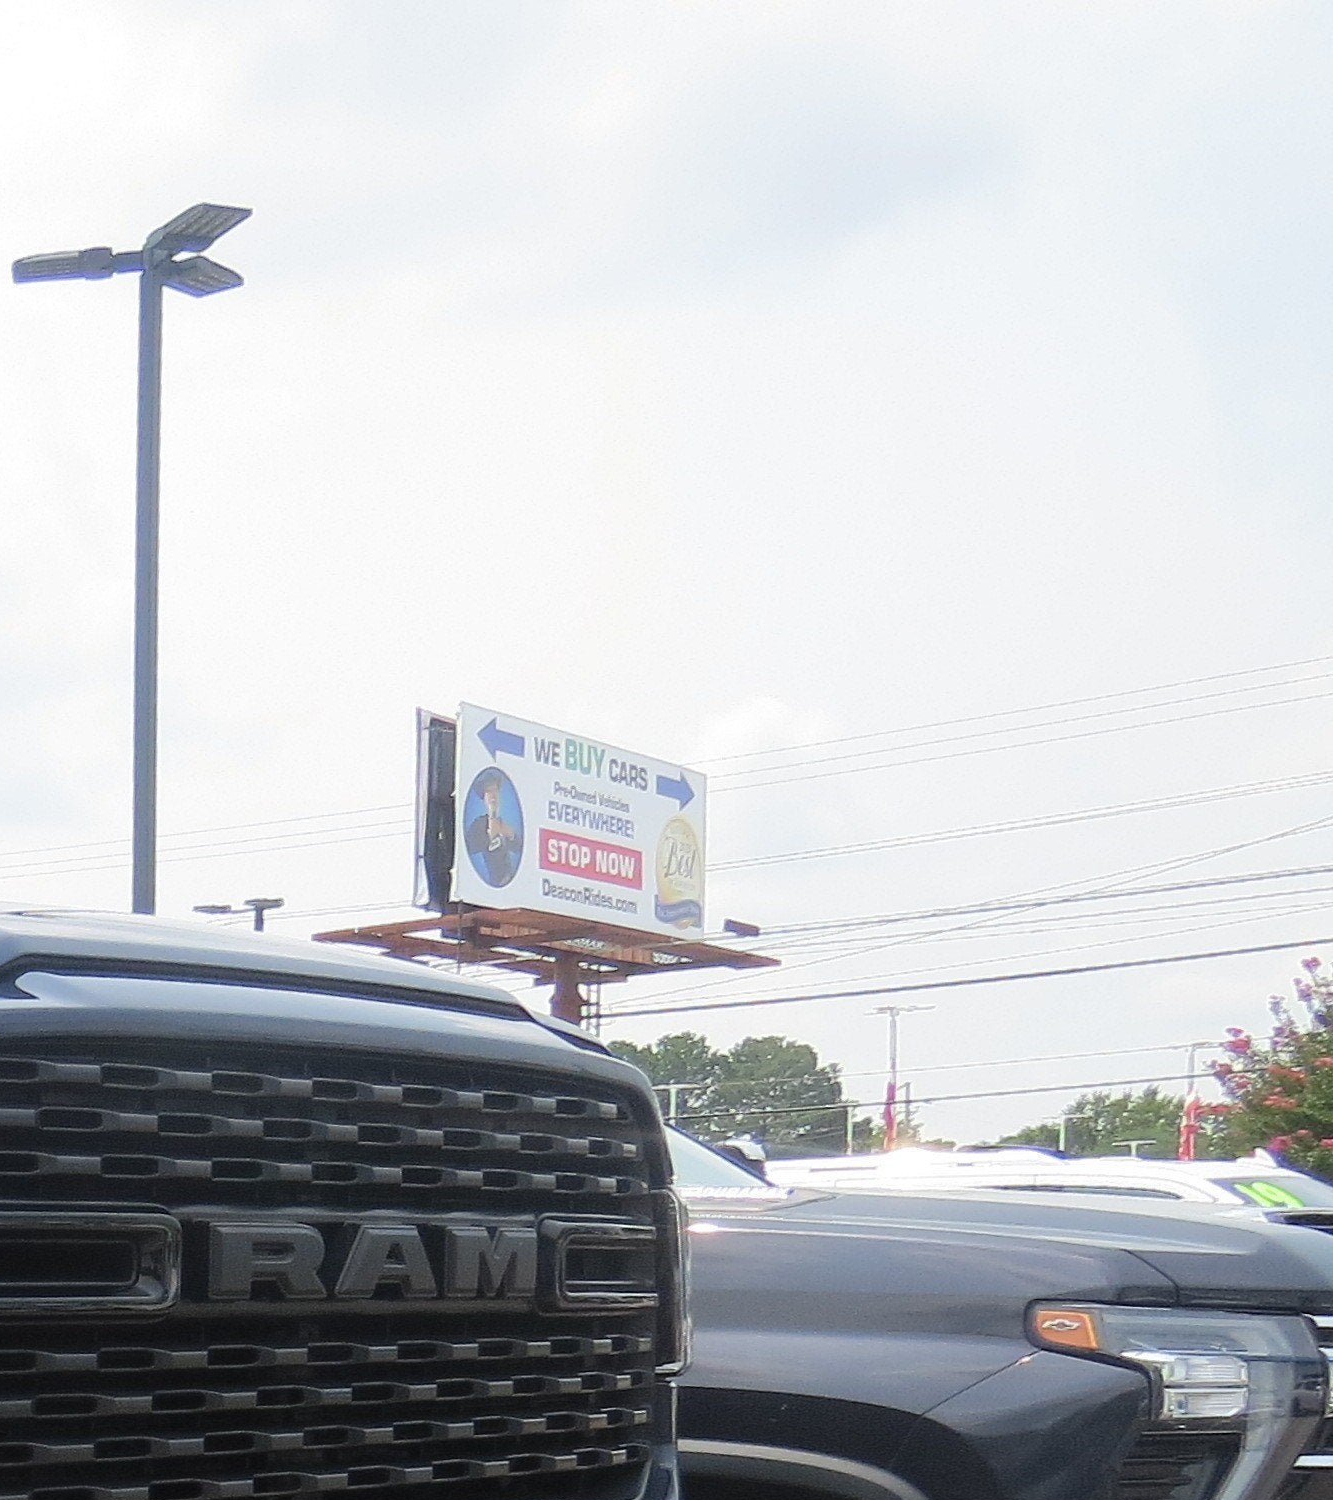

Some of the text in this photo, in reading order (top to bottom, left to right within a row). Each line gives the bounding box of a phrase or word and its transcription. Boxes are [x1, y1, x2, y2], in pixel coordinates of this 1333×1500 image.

[533, 737, 648, 792] WE BUY CARS
[547, 838, 635, 880] STOP NOW
[542, 878, 638, 914] DeaconRides.com
[208, 1221, 537, 1300] RAM
